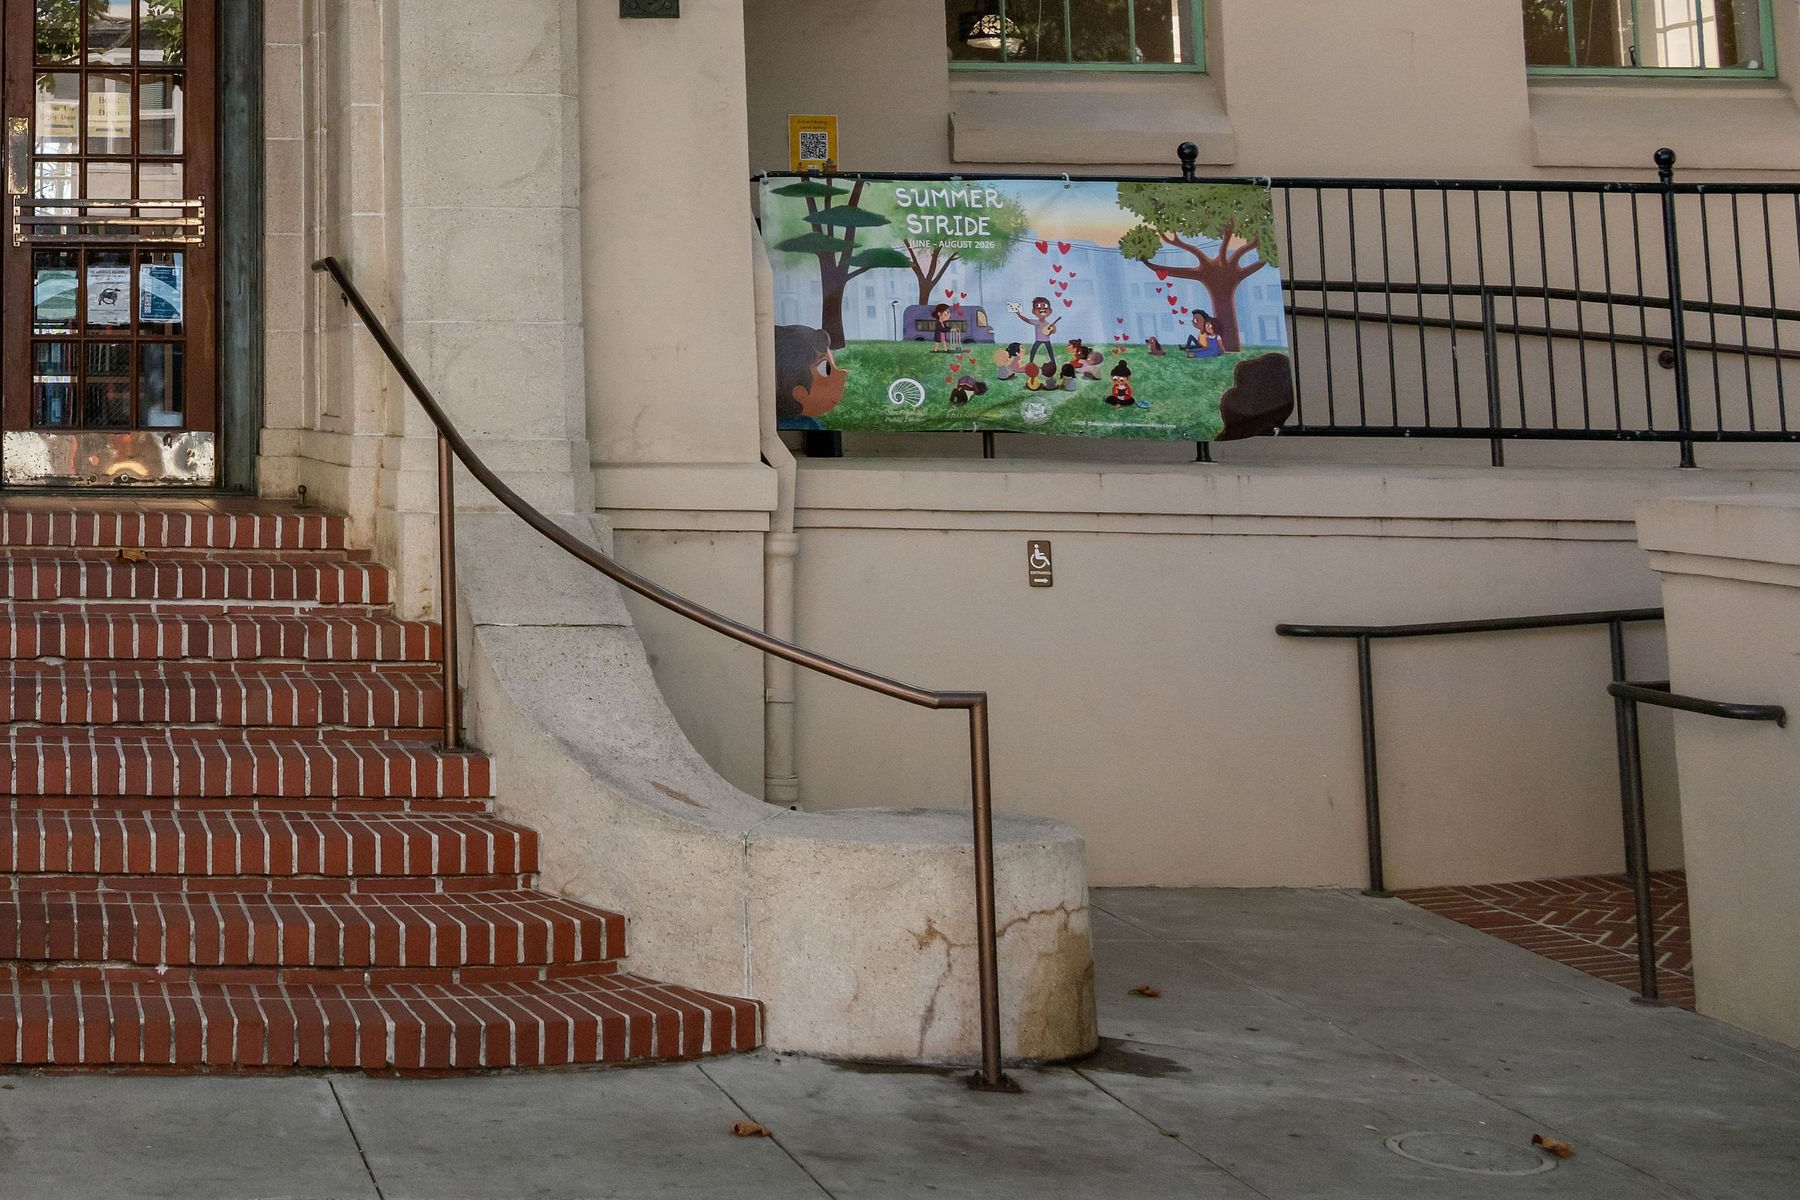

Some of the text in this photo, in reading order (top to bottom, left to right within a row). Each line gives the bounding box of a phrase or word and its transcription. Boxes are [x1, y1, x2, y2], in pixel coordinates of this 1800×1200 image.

[895, 187, 1004, 209] SUMMER
[906, 213, 991, 237] STRIDE
[909, 239, 930, 248] JUNE
[938, 240, 972, 248] AUGUST
